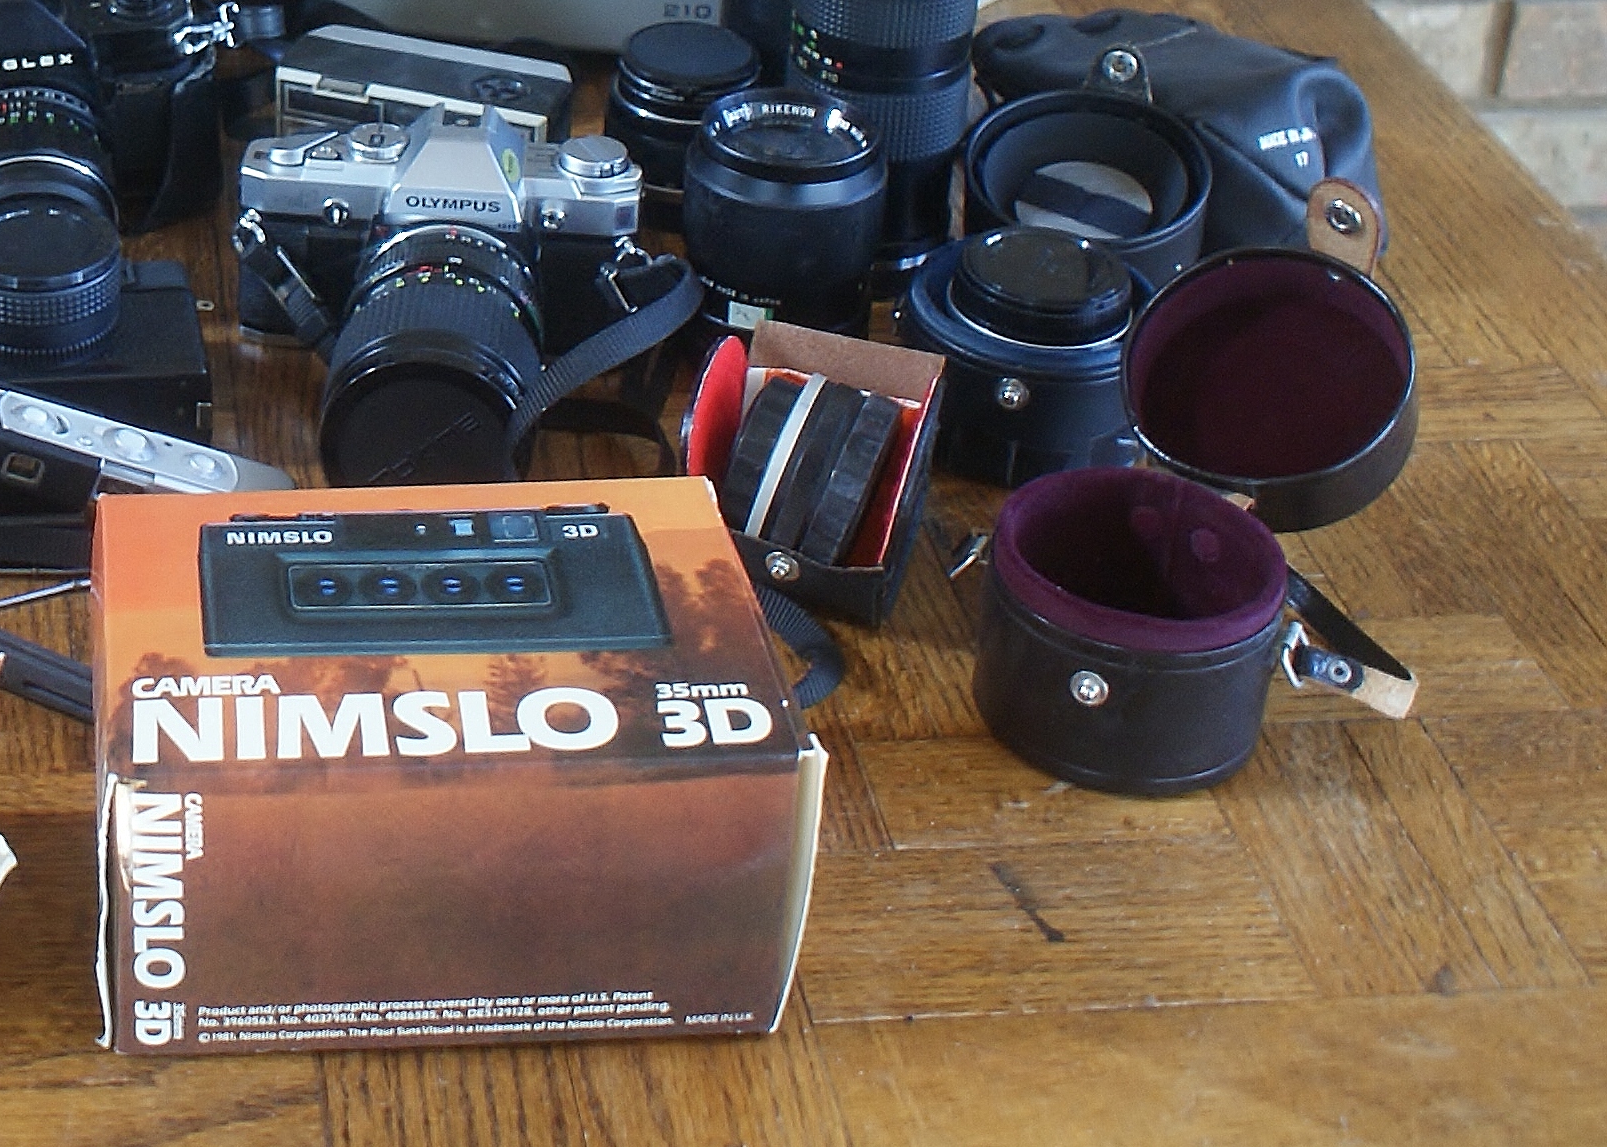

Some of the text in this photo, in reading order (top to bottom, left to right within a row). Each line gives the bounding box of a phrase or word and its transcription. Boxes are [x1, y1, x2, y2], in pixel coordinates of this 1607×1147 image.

[663, 3, 712, 20] 210
[761, 103, 817, 119] RIKENON
[405, 195, 502, 213] OLYMPUS
[226, 523, 600, 546] NIMSLO 3D
[131, 674, 281, 698] CAMERA
[655, 682, 750, 699] 35mm
[131, 687, 775, 765] NIMSLO 3D
[183, 791, 205, 862] CAMERA
[131, 791, 188, 1046] NIMSLO 3D
[198, 990, 653, 1017] Product and/or photographic process covered by one or more of U.S. Patent
[198, 1017, 220, 1027] No.
[279, 1014, 301, 1025] No.
[360, 1011, 385, 1022] No.
[442, 1009, 463, 1019] No.
[537, 1005, 571, 1016] other
[573, 1003, 614, 1016] patent
[349, 1026, 368, 1037] The
[370, 1026, 395, 1036] Four
[422, 1024, 454, 1035] Visual
[475, 1021, 532, 1032] trademark
[533, 1019, 547, 1031] of
[547, 1019, 566, 1030] the
[684, 1014, 719, 1025] MADE
[720, 1013, 734, 1023] IN
